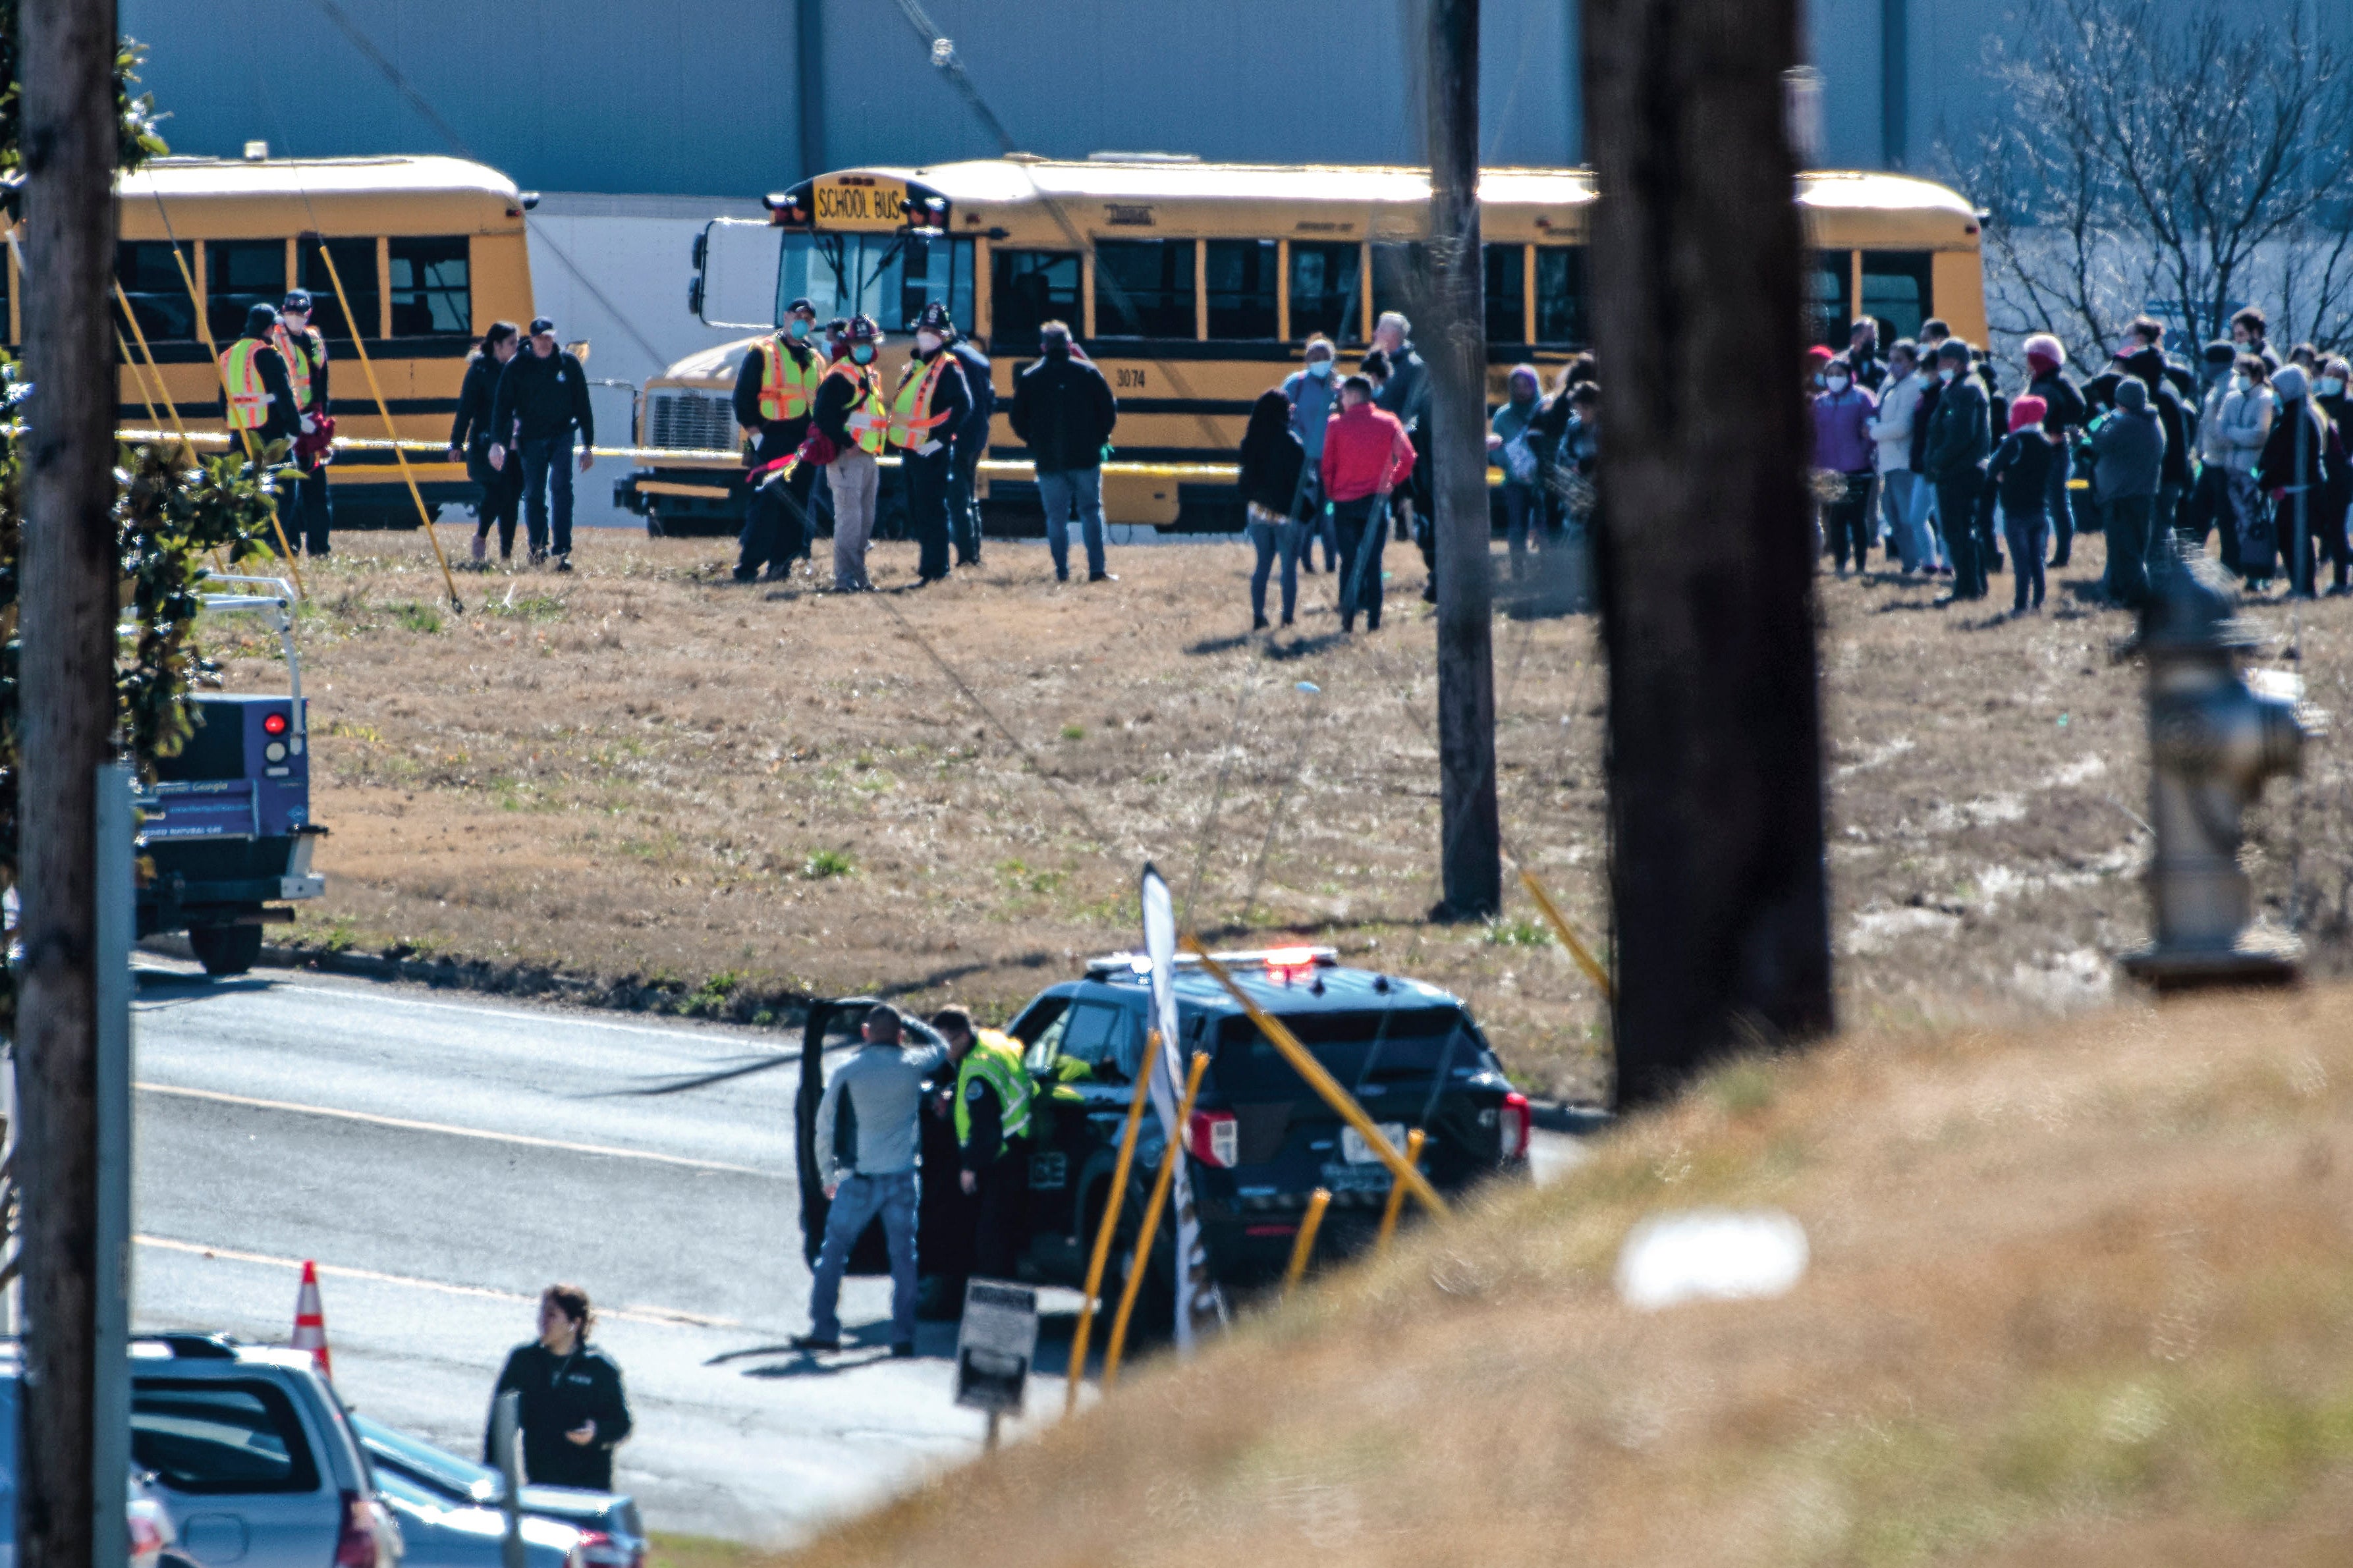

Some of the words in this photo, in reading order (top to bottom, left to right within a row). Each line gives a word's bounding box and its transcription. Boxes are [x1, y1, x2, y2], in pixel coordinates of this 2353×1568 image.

[819, 188, 870, 219] SCHOOL
[874, 190, 900, 220] BUS
[1117, 369, 1146, 388] 3074
